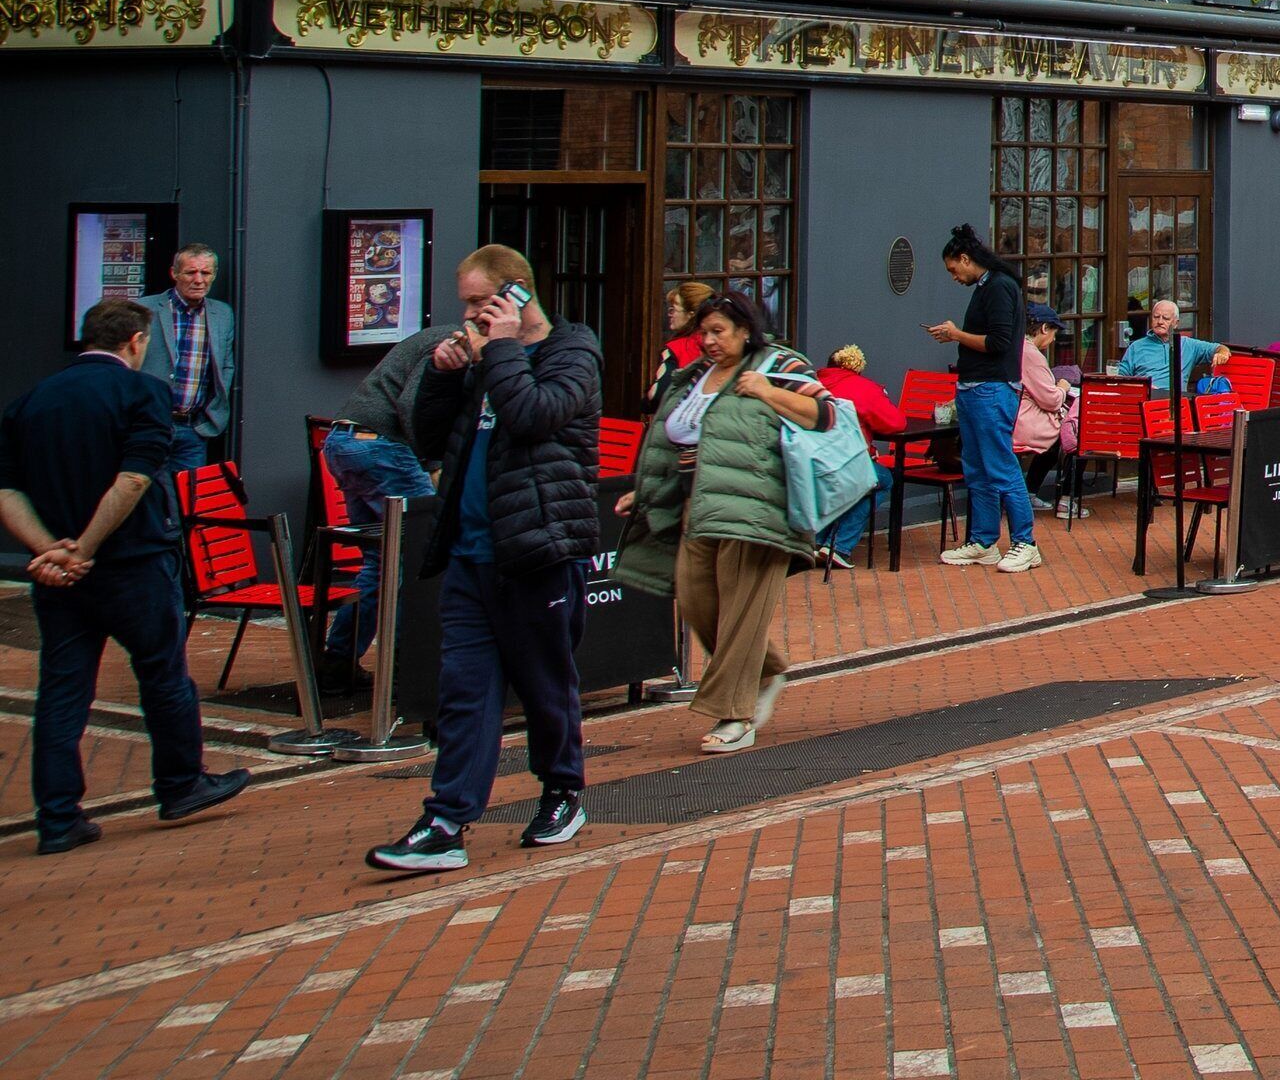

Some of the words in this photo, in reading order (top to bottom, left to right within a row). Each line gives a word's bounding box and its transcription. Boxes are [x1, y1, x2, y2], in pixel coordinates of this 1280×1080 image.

[732, 16, 829, 67] THE
[850, 22, 995, 74] LINEN
[1007, 34, 1176, 85] WEAVER
